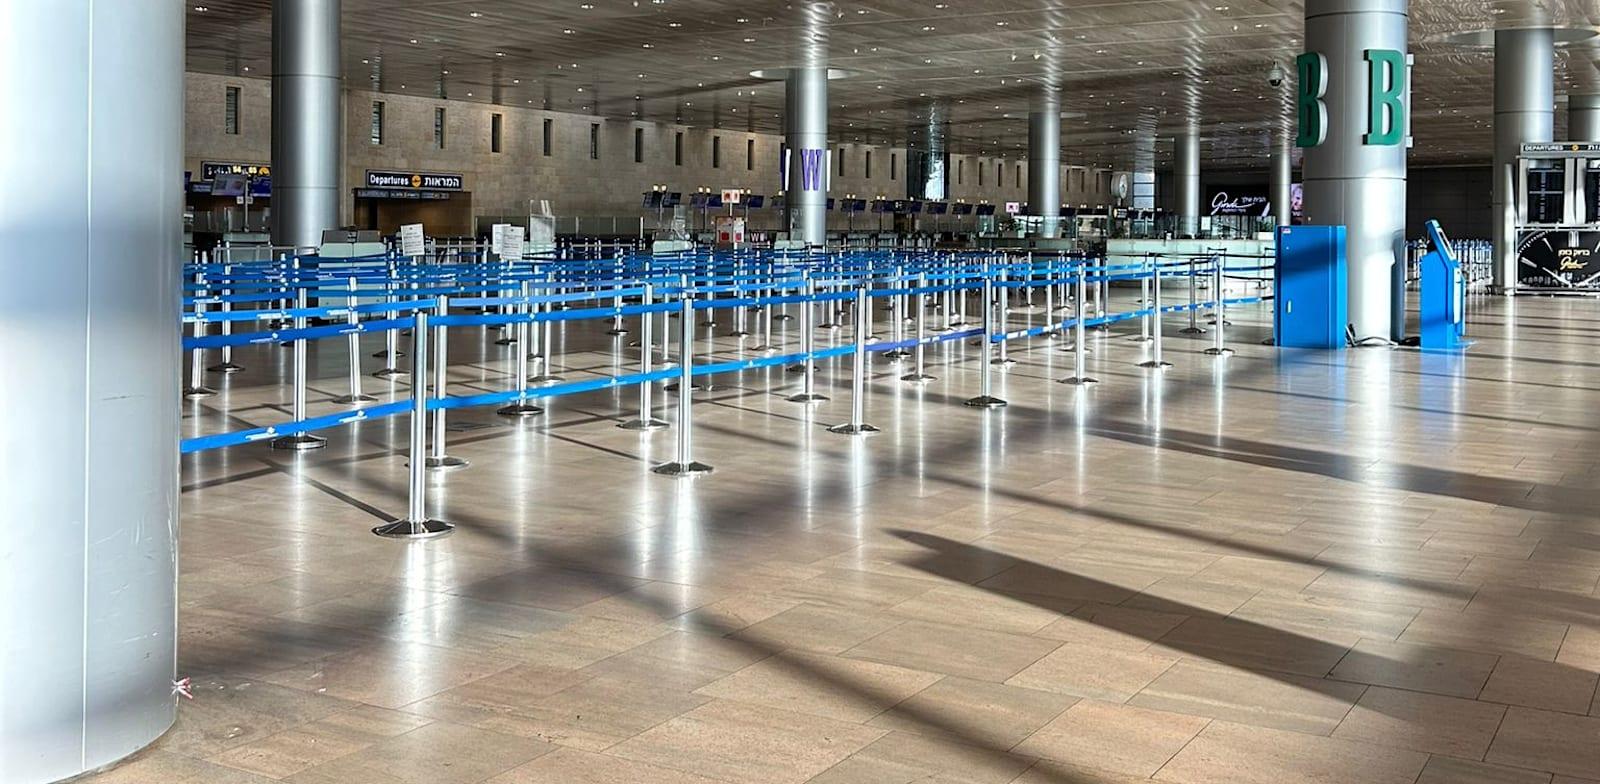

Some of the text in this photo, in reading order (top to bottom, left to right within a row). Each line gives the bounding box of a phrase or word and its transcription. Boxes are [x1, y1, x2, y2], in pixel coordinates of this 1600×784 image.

[1296, 51, 1328, 147] B
[1363, 49, 1404, 146] B
[370, 174, 409, 185] Departures
[424, 176, 459, 187] המראות
[801, 149, 822, 191] W
